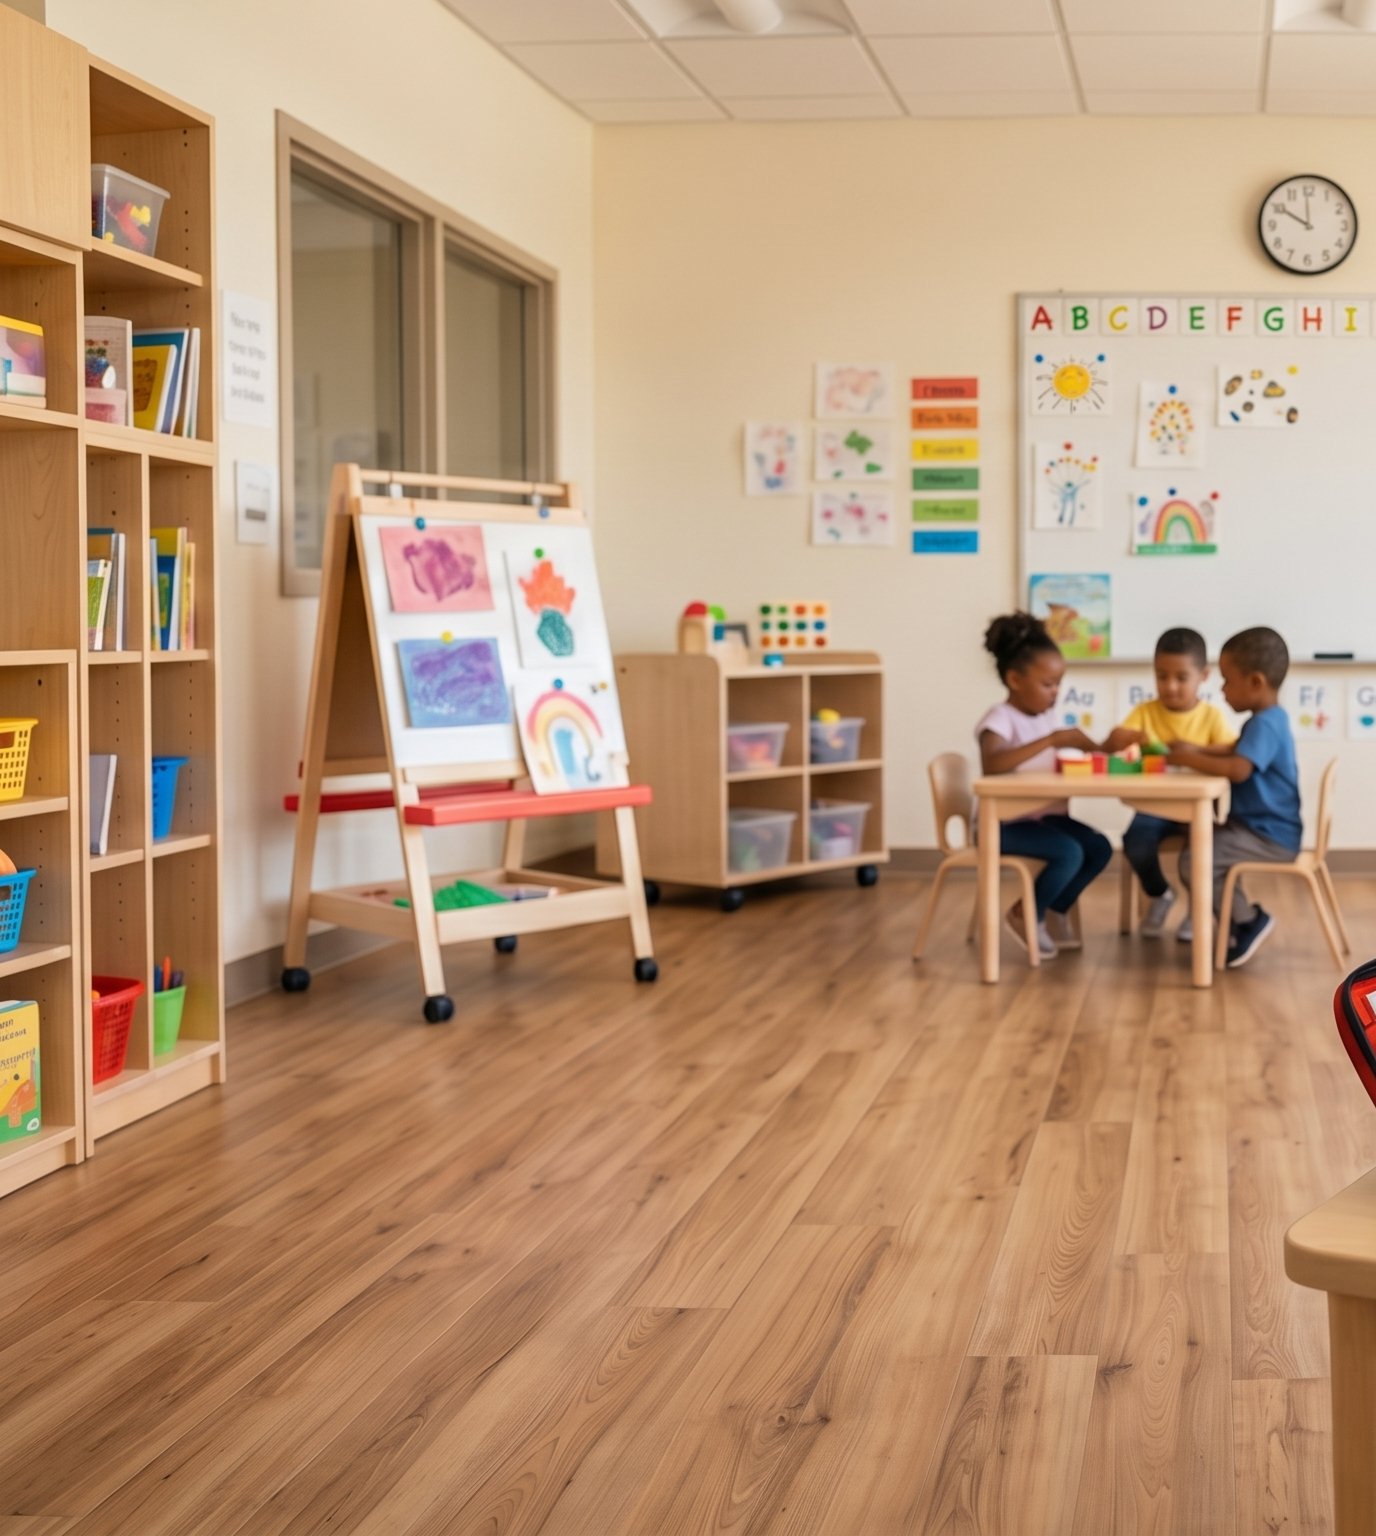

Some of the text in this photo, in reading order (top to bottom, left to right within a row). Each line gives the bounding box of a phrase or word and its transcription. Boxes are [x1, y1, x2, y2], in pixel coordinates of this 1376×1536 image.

[1335, 202, 1344, 215] 2
[1267, 219, 1277, 232] 9
[1340, 219, 1348, 232] 3
[1273, 237, 1282, 249] 8
[1286, 248, 1295, 262] 7
[1303, 253, 1312, 267] 6
[1322, 249, 1331, 262] 5
[1031, 305, 1053, 330] A
[1071, 305, 1089, 330] B
[1108, 305, 1129, 331] C
[1146, 306, 1168, 330] D
[1189, 306, 1206, 331] E
[1226, 307, 1243, 331] F
[1263, 307, 1285, 331] G
[1303, 307, 1323, 331] H
[1344, 307, 1357, 332] I
